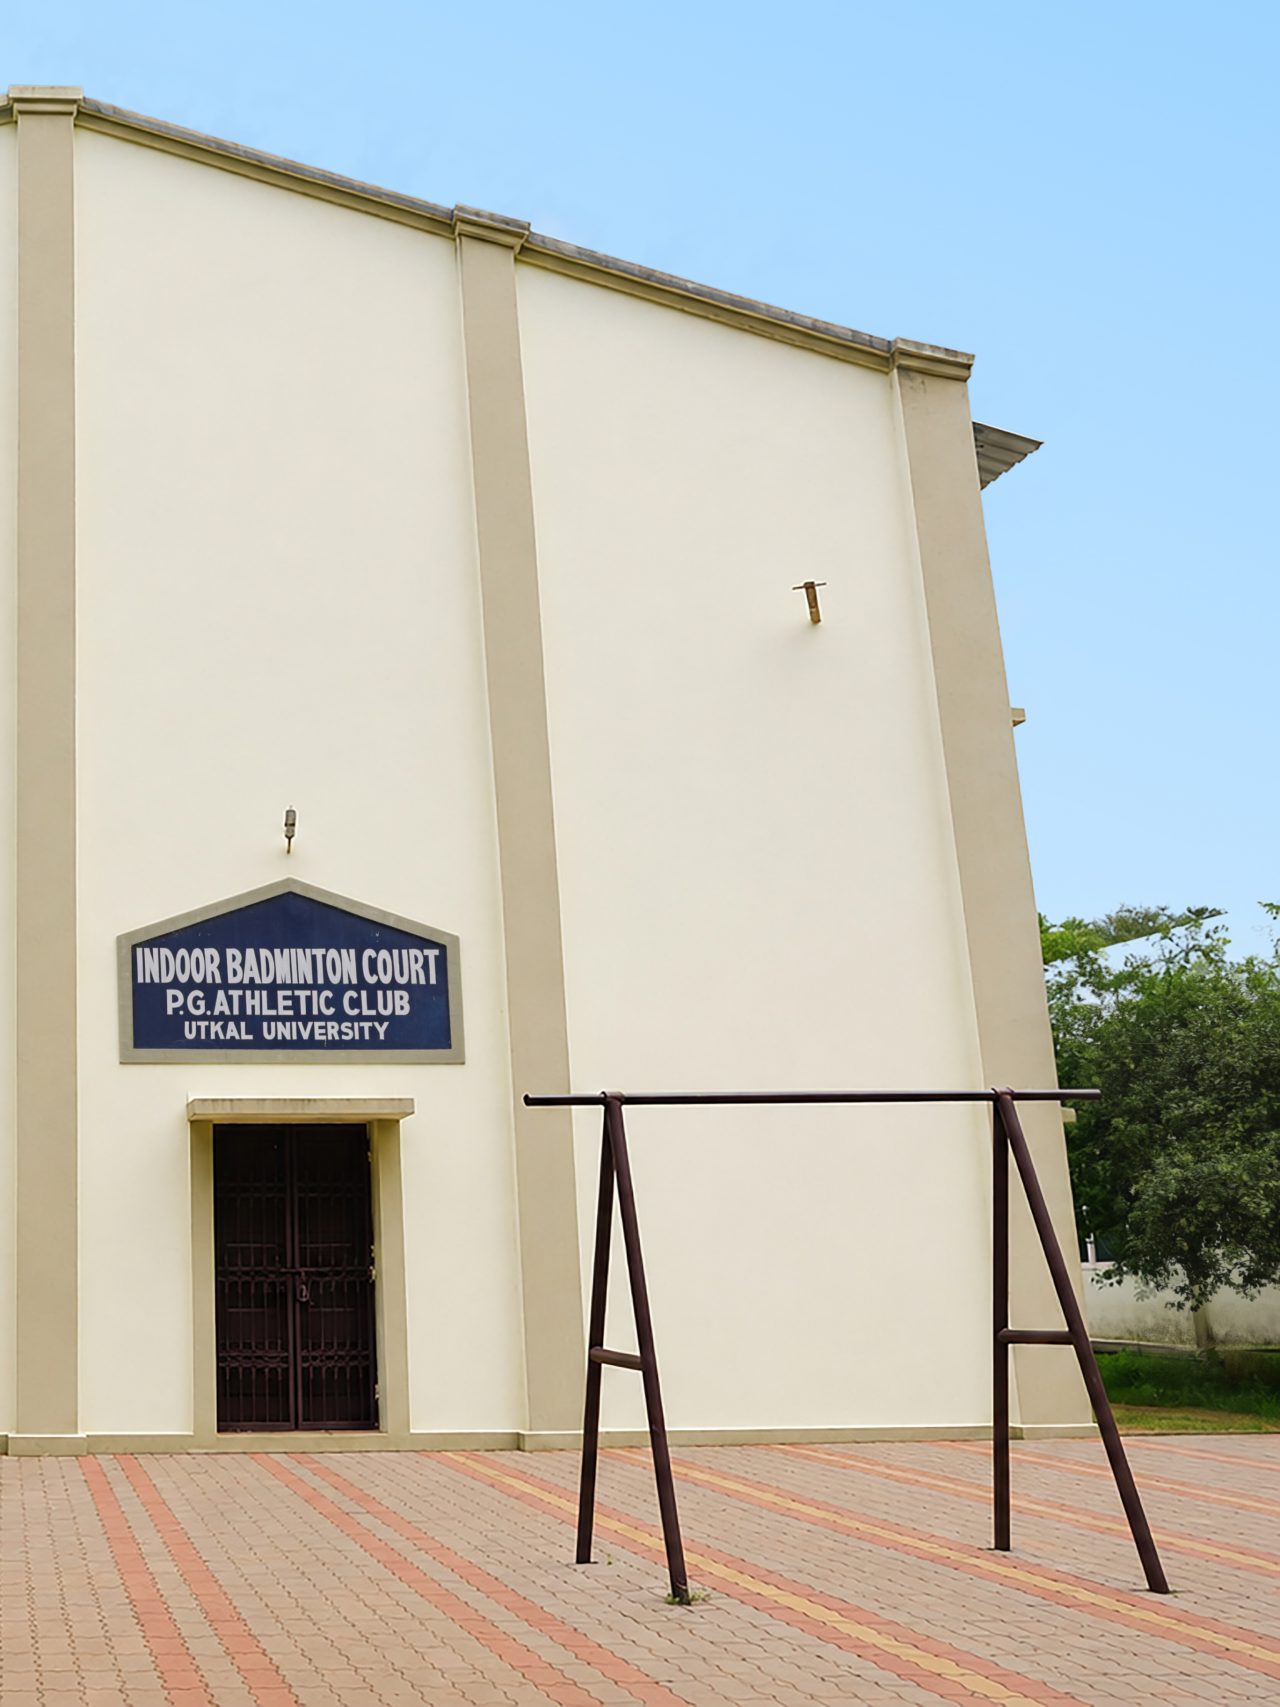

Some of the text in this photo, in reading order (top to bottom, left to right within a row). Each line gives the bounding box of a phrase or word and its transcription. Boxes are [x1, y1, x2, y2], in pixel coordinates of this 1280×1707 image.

[136, 947, 439, 985] INDOOR BADMINTON COURT
[342, 990, 411, 1015] CLUB
[184, 1021, 389, 1040] UTKAL UNIVERSITY
